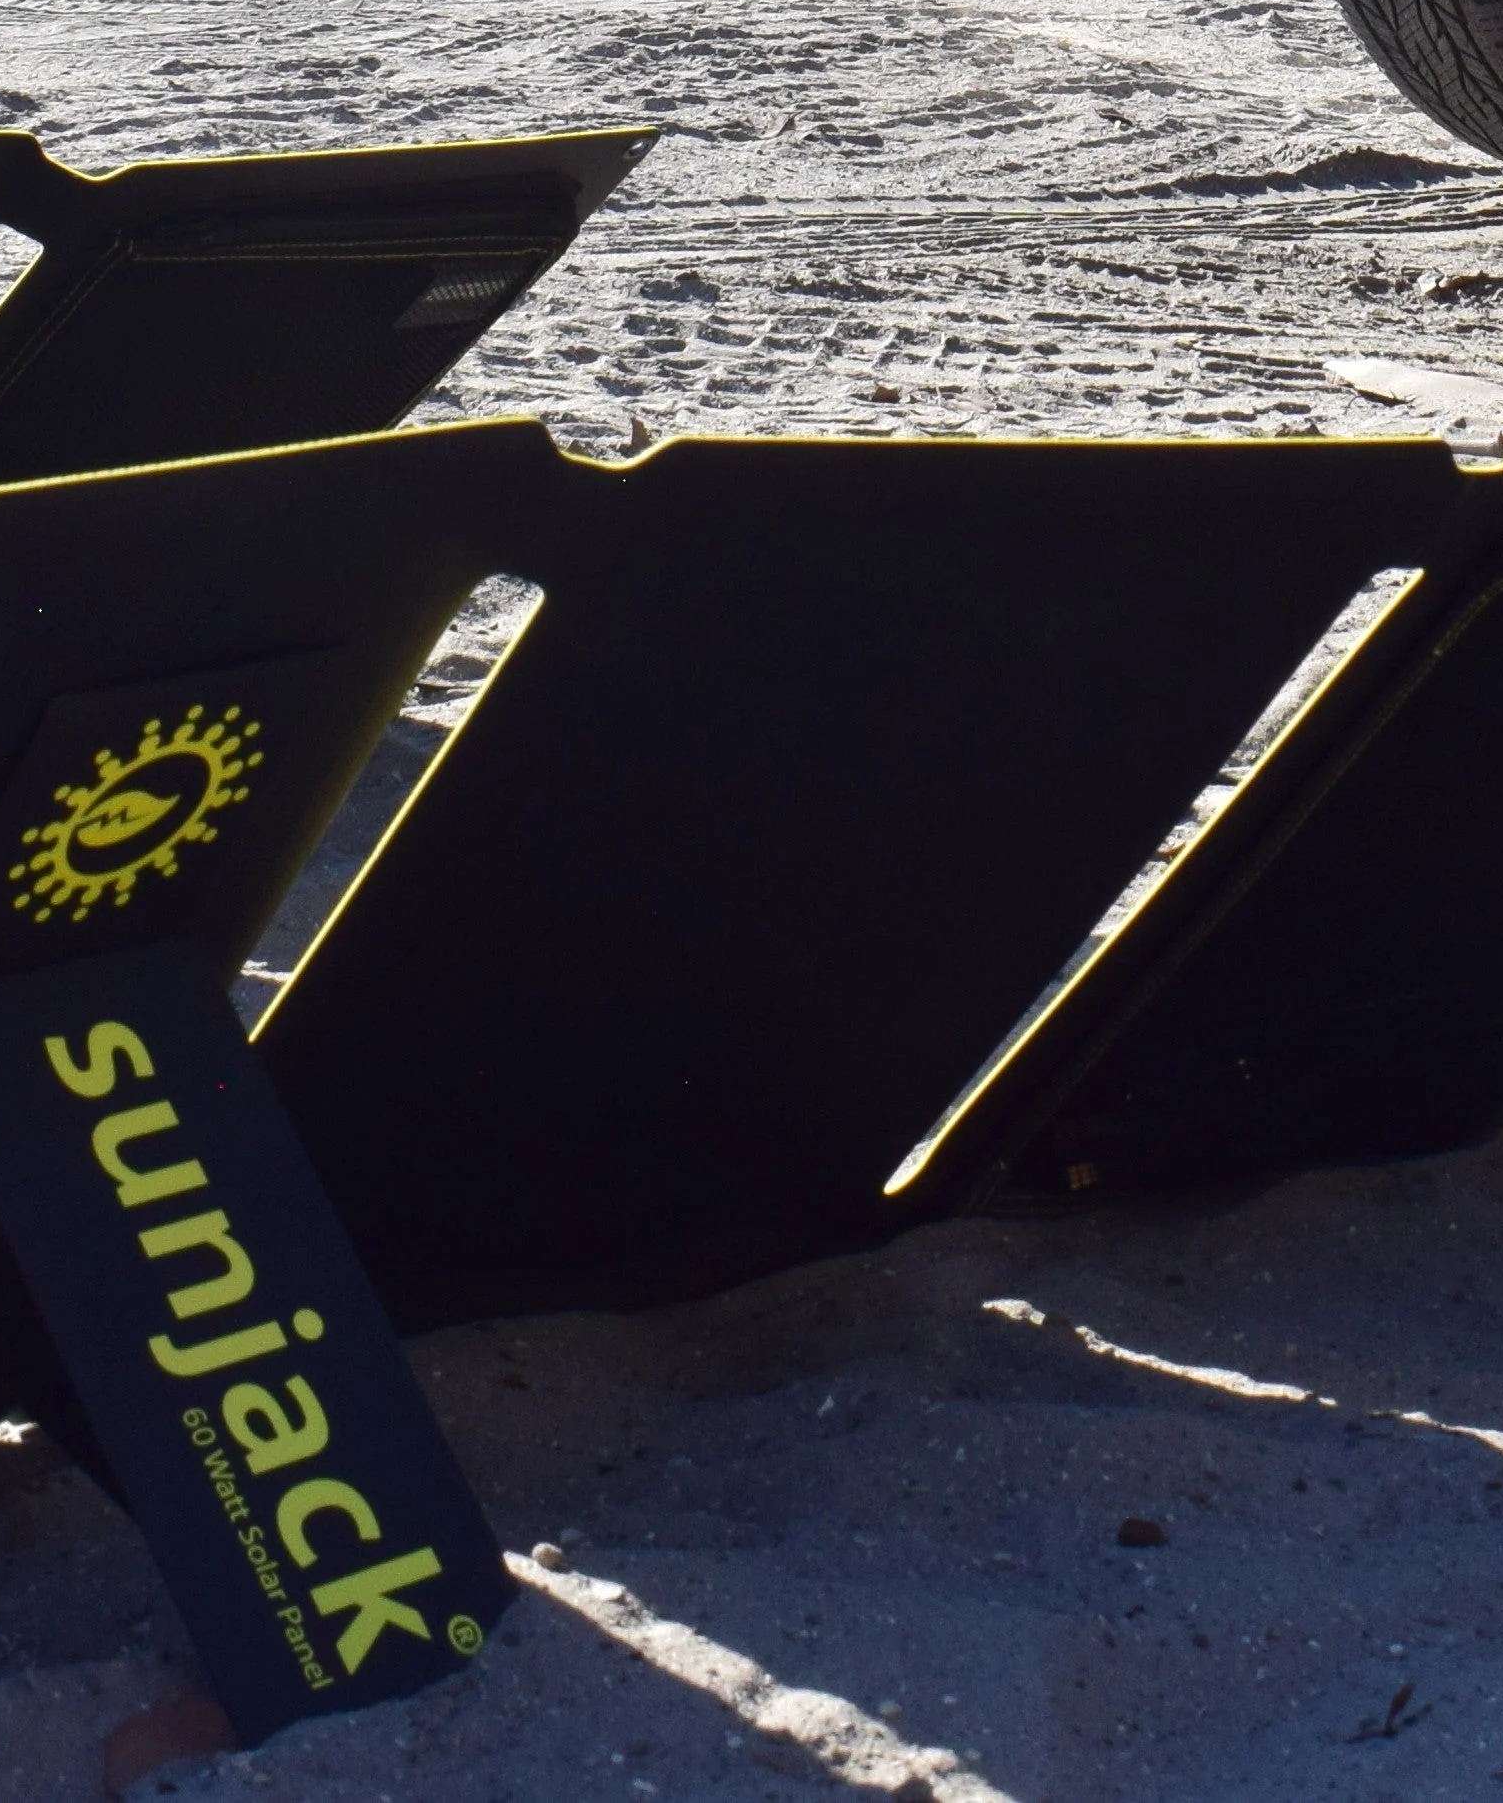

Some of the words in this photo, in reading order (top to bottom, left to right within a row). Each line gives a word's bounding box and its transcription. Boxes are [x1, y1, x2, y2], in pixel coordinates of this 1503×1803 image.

[183, 1407, 216, 1447] 60
[203, 1447, 250, 1524] Watt
[238, 1525, 287, 1602] Solar
[276, 1606, 335, 1690] Panel
